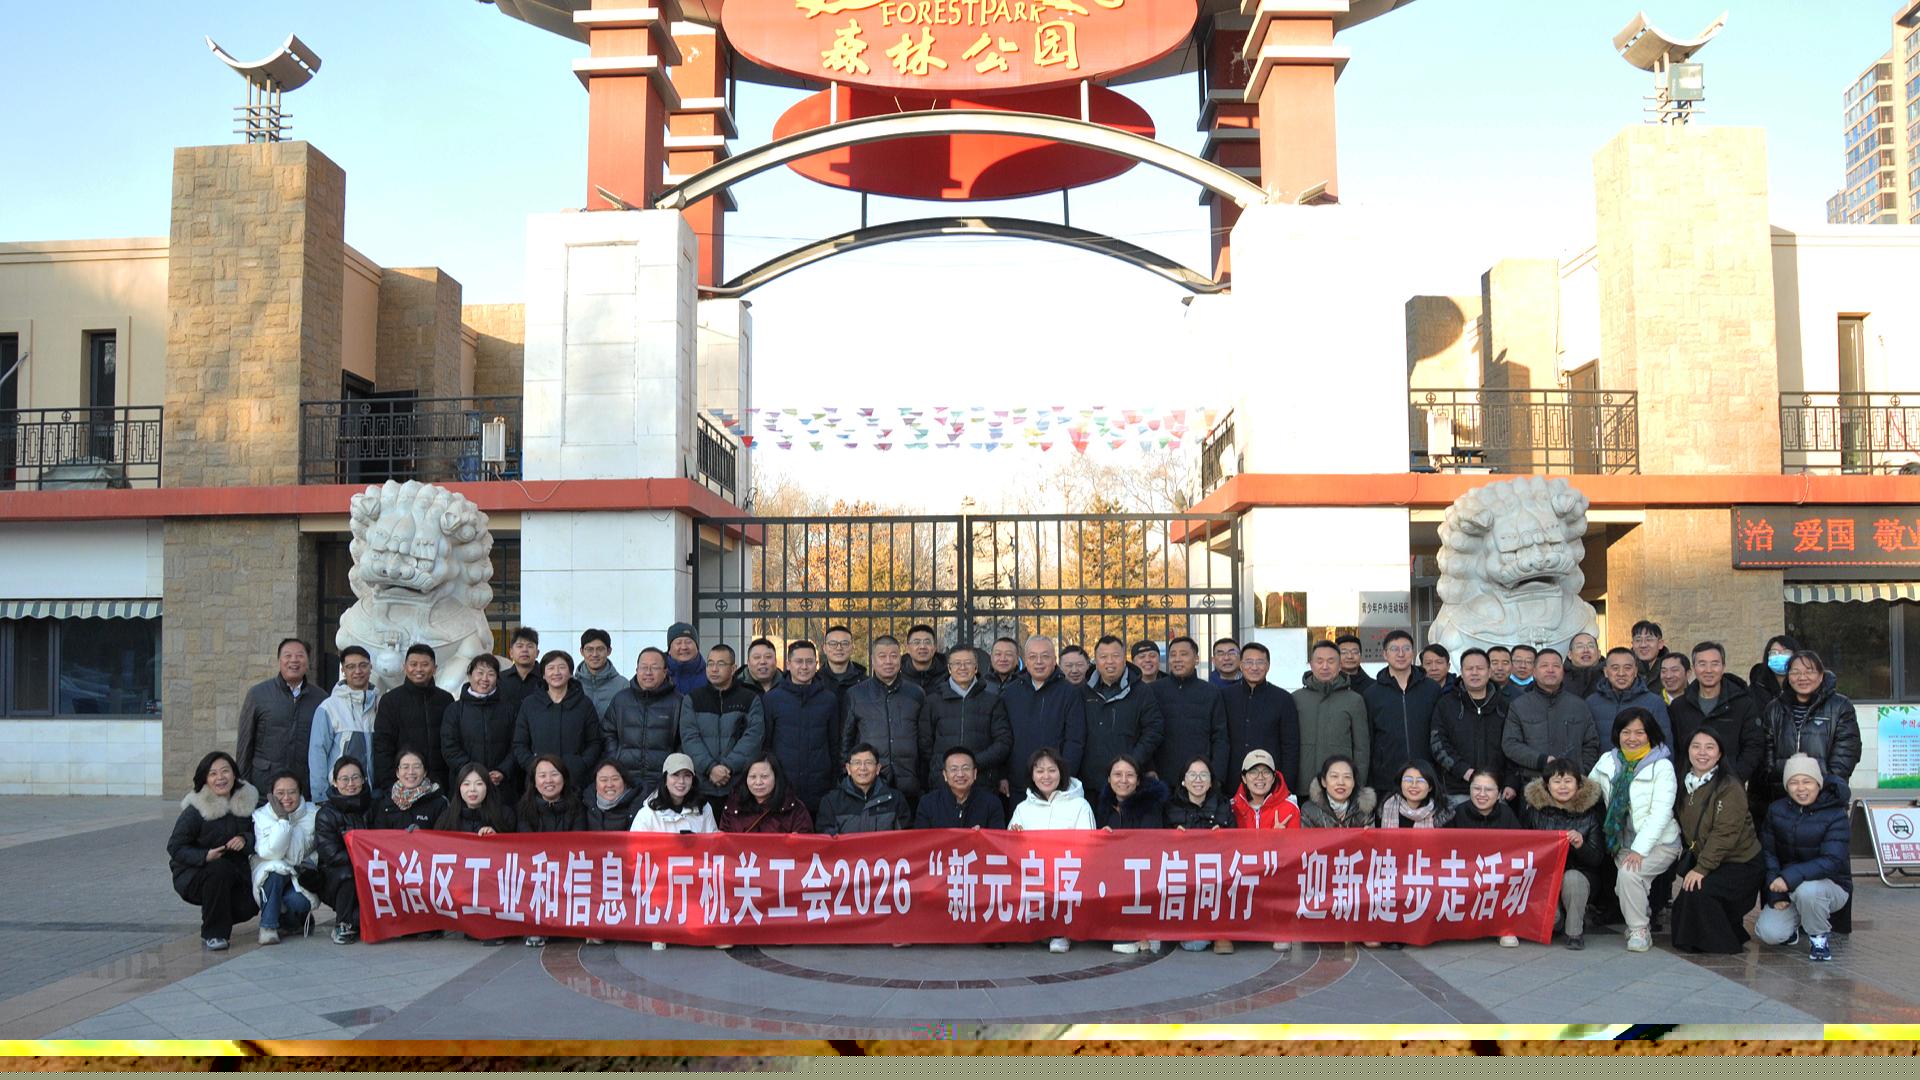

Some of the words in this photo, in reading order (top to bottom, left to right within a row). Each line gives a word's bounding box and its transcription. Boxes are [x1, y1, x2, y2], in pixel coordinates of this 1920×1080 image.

[821, 19, 1079, 75] 森林公园
[1743, 518, 1774, 551] 治
[1792, 518, 1855, 552] 爱国
[367, 848, 912, 926] 自治区工业和信息化厅机关工会2026
[1296, 849, 1538, 922] 迎新健步走活动
